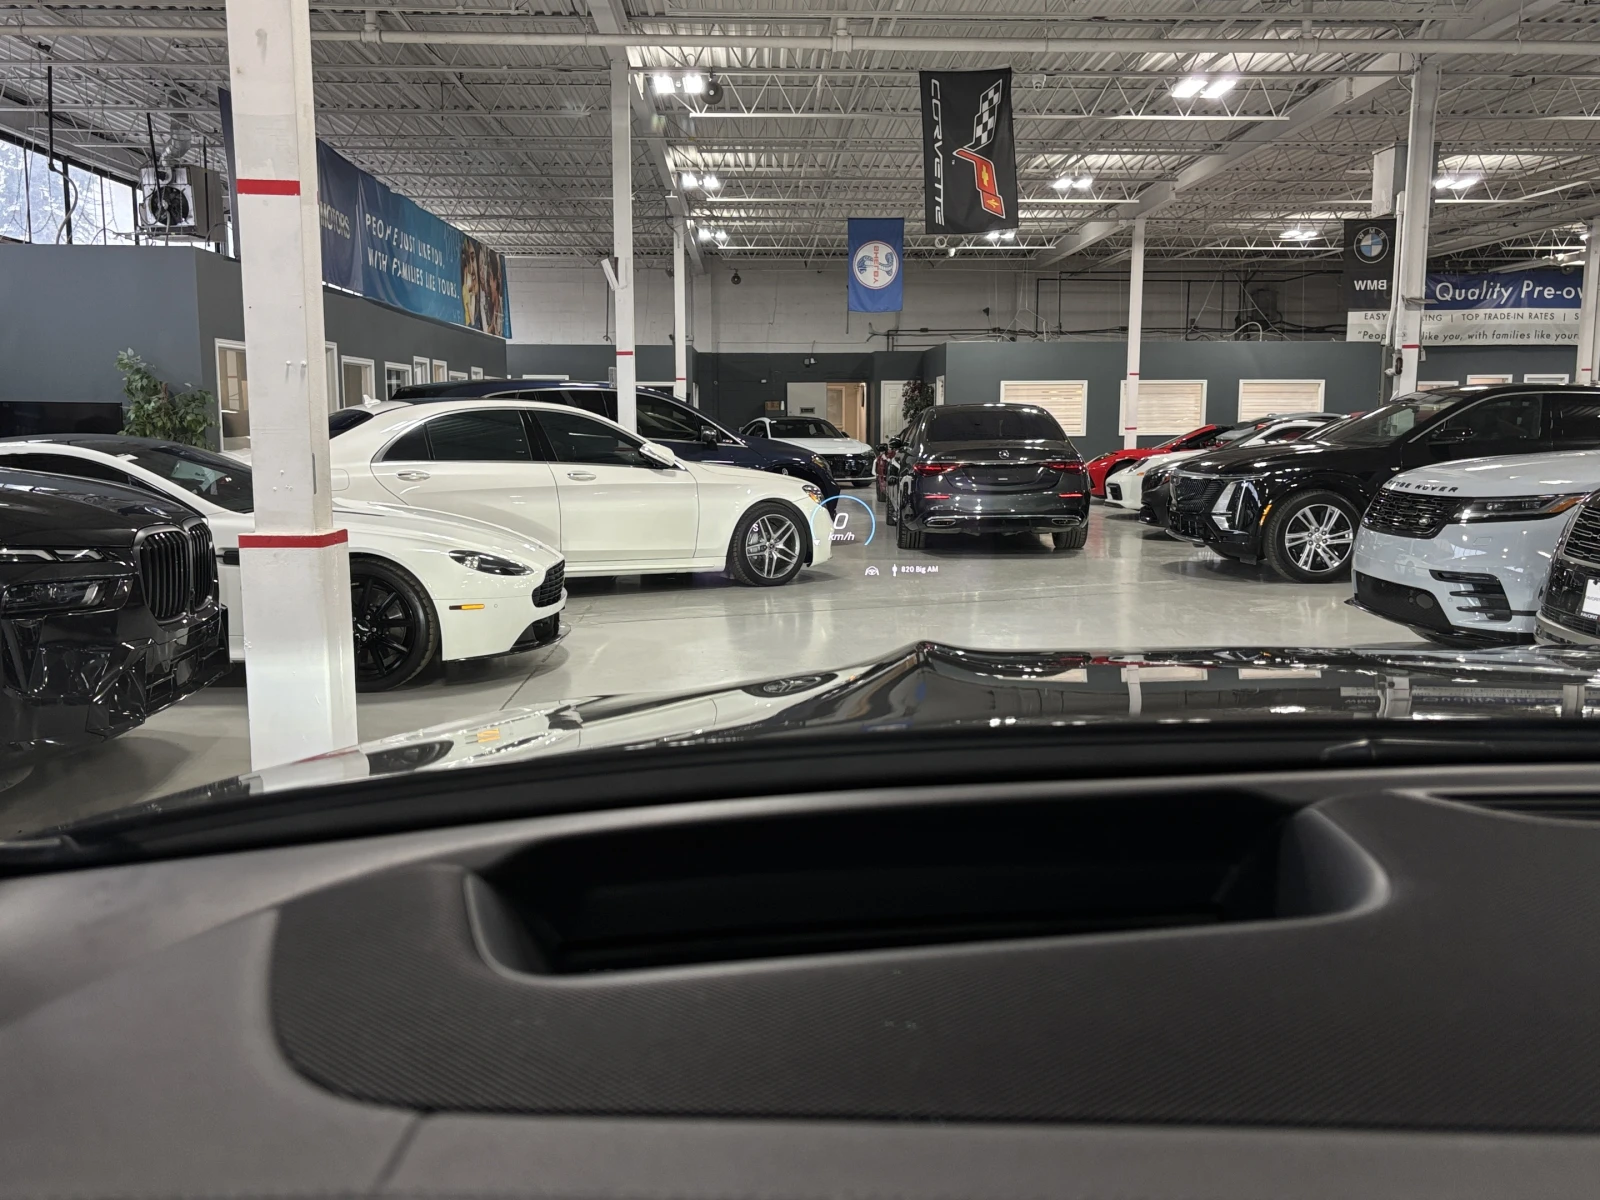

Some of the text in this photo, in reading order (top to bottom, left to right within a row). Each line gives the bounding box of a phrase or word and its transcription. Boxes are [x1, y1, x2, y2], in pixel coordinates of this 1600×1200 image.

[931, 78, 945, 226] CORVETTE
[400, 231, 415, 254] JUST
[367, 246, 388, 273] WITH
[1435, 280, 1513, 305] Quality
[1364, 312, 1387, 320] EASY
[1461, 313, 1480, 321] TOP
[1483, 312, 1524, 320] TRADE-IN
[1528, 312, 1555, 320] RATES
[1422, 331, 1439, 341] like
[1442, 333, 1463, 343] you,
[1467, 330, 1488, 339] with
[1491, 329, 1531, 339] families
[1534, 330, 1551, 339] like
[1415, 484, 1459, 493] ROVER
[833, 512, 849, 530] 0
[827, 531, 856, 541] km/h
[901, 565, 939, 574] 820 Big AM
